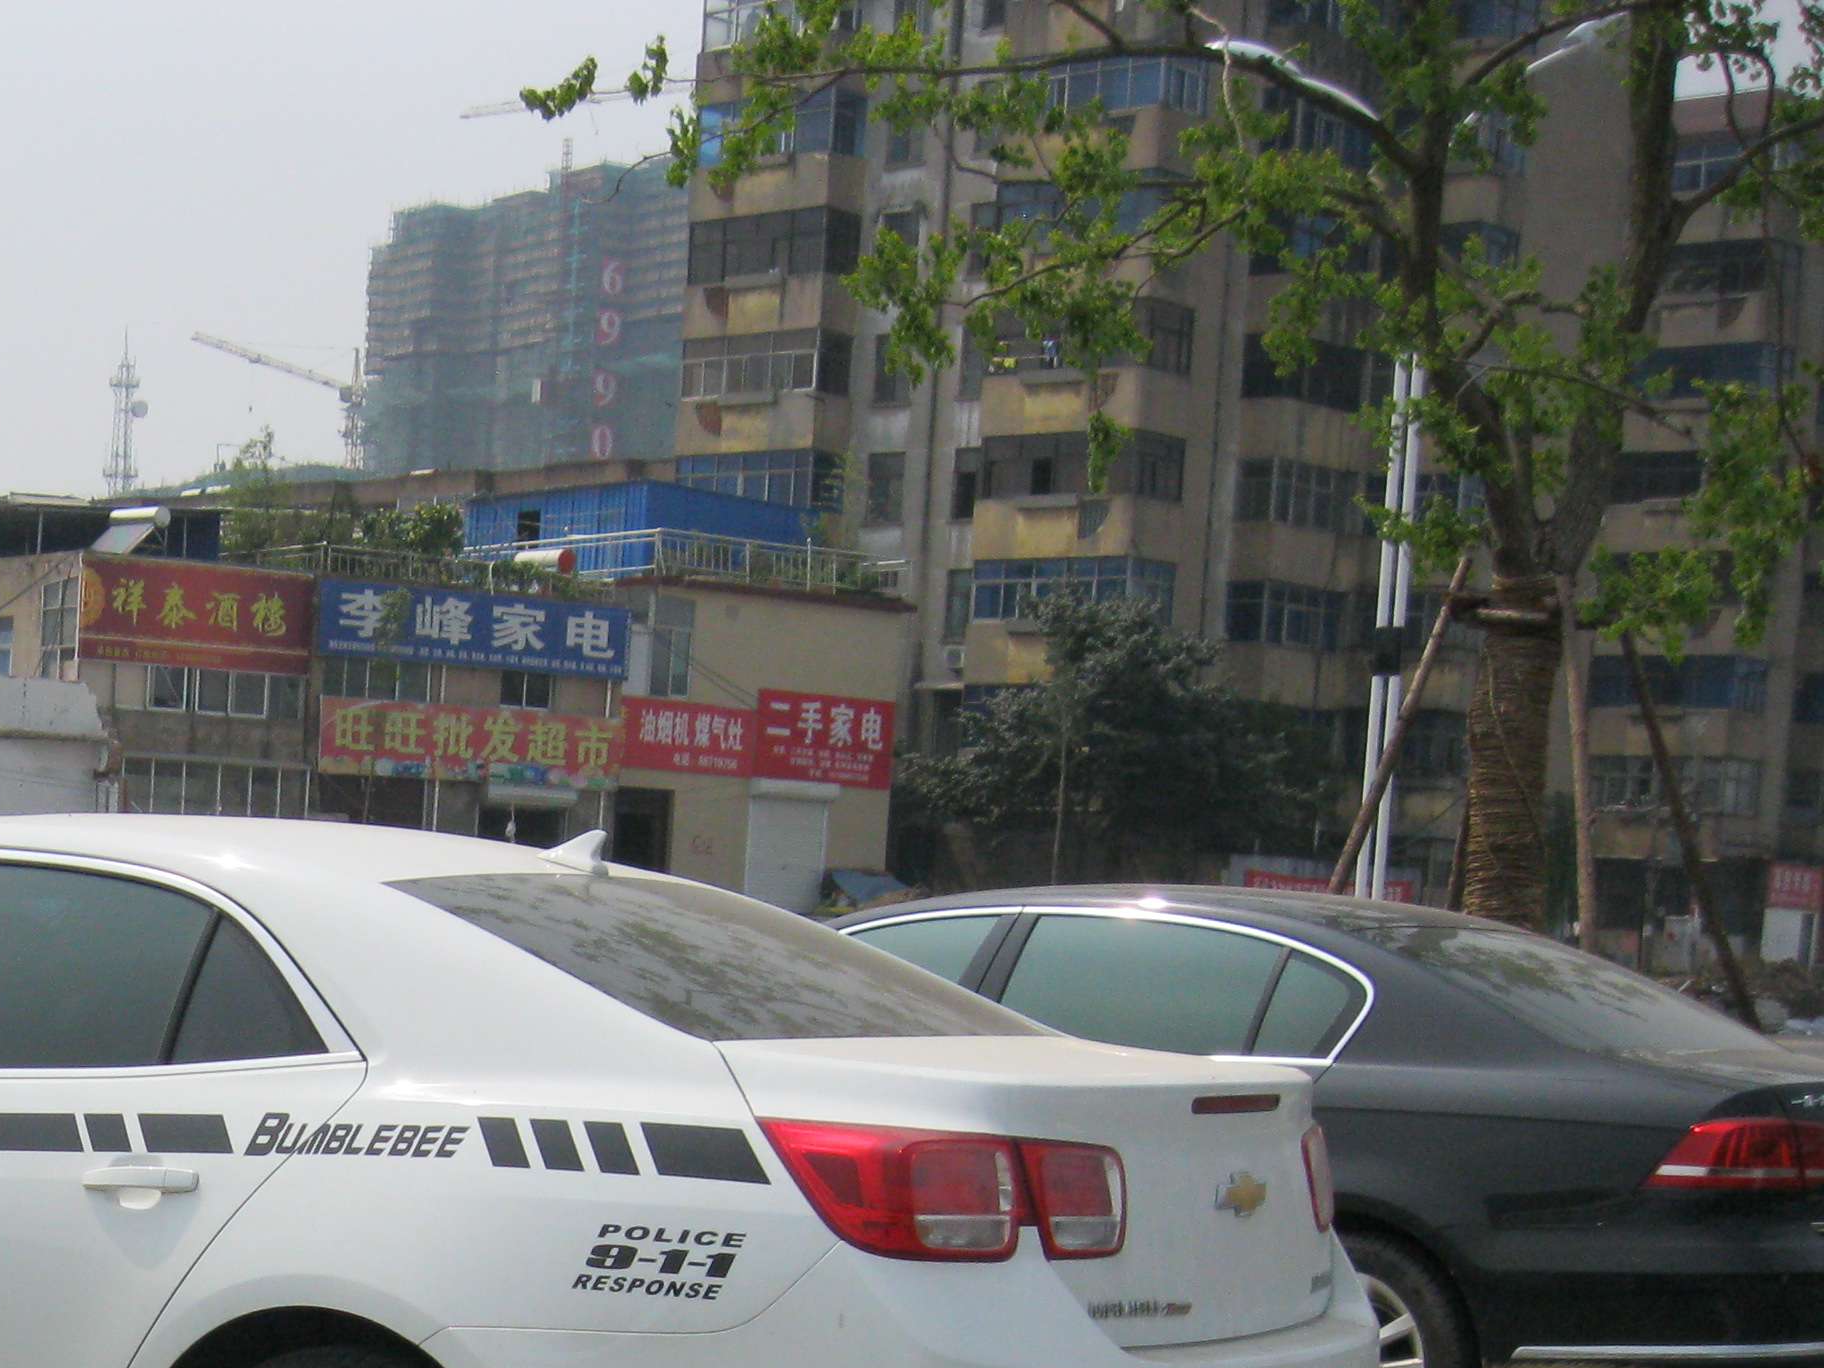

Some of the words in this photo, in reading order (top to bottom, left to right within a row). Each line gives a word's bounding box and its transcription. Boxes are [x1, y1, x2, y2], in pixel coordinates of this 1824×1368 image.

[111, 577, 287, 637] 祥泰酒楼
[337, 588, 615, 660] 李峰家电
[335, 708, 614, 768] 旺旺批发超市
[639, 707, 689, 747] 油烟机
[694, 711, 743, 751] 煤气灶
[766, 700, 883, 750] 二手家电
[596, 1222, 748, 1250] POLICE
[584, 1242, 737, 1280] 9-1-1
[572, 1272, 723, 1302] RESPONSE
